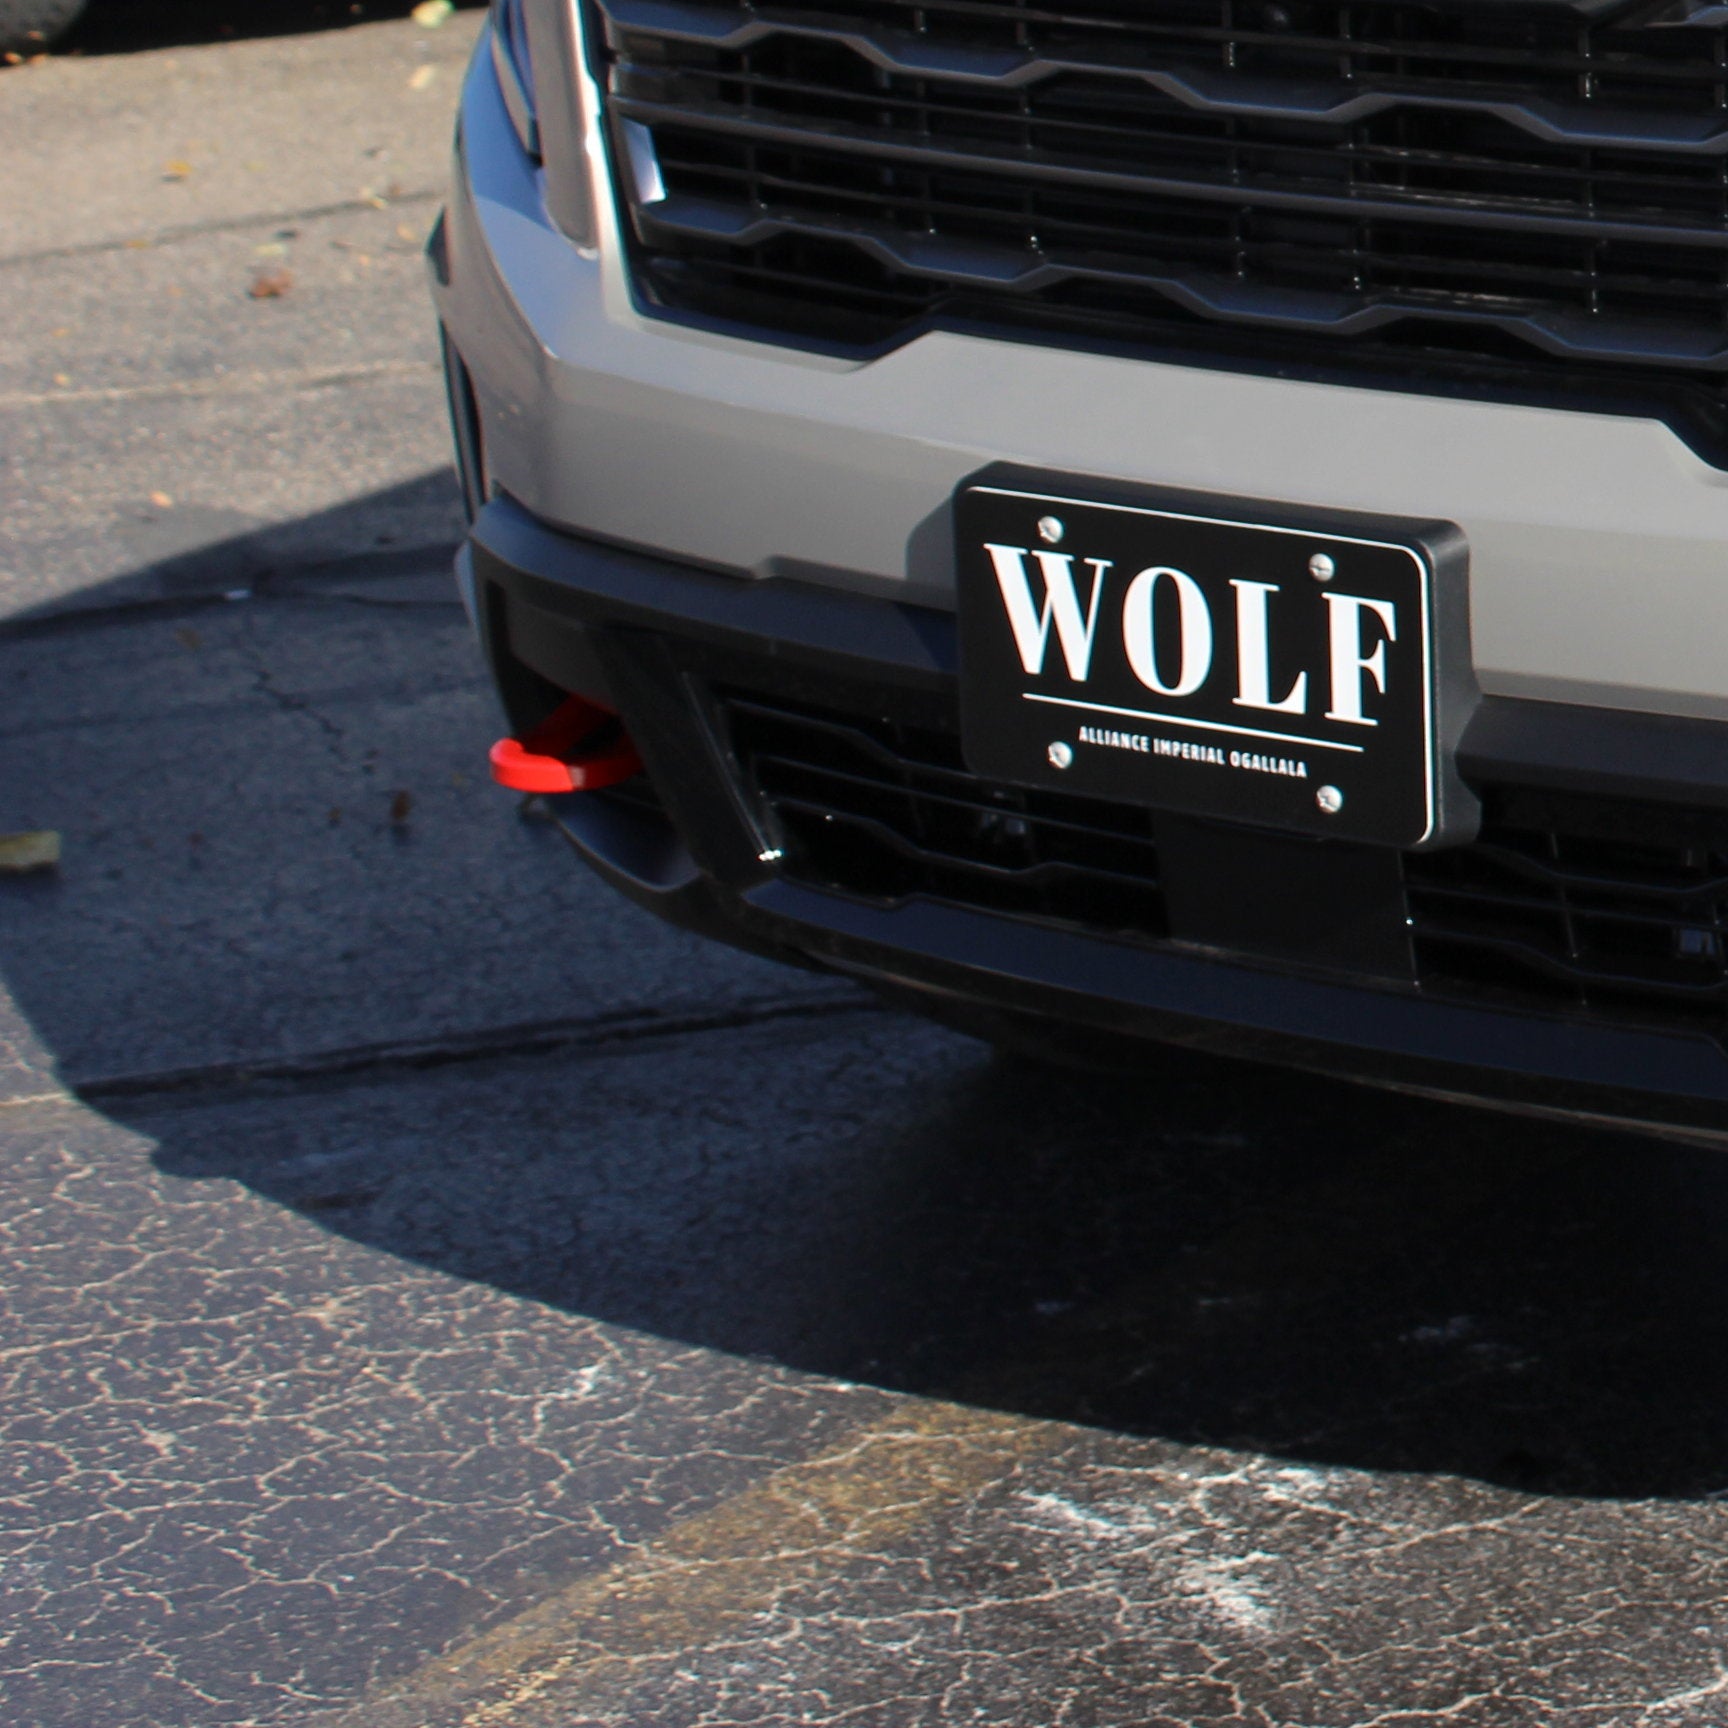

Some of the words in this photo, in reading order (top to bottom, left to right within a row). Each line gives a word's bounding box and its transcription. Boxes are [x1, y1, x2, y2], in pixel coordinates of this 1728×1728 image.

[983, 543, 1397, 726] WOLF
[1078, 725, 1149, 753] ALLIANCE
[1153, 738, 1226, 765] IMPERIAL
[1229, 751, 1307, 778] OGALLALA
